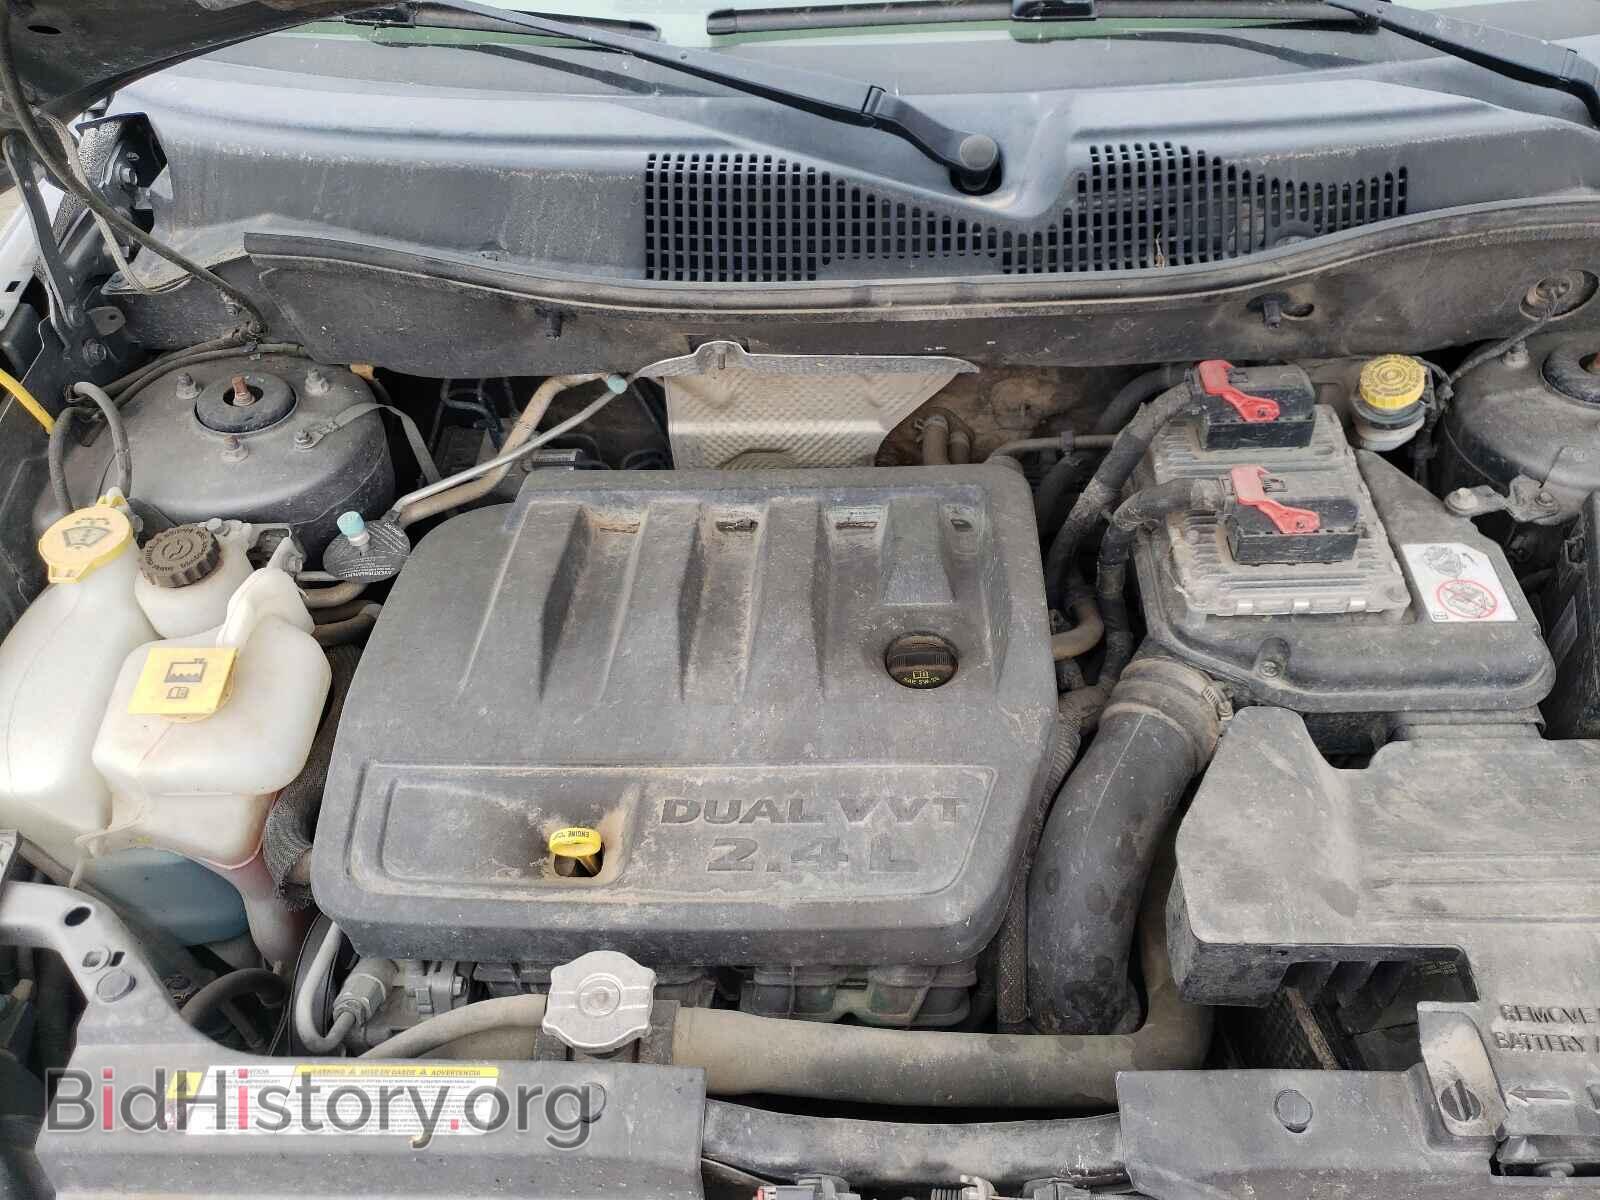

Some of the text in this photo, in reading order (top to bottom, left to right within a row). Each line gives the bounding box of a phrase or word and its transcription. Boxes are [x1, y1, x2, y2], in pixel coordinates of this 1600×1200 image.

[660, 797, 962, 825] DUAL VVT
[567, 830, 590, 838] ENGINE
[706, 838, 919, 873] 2.4L
[1500, 1004, 1597, 1024] REMOVE
[1495, 1031, 1586, 1053] BATTERY
